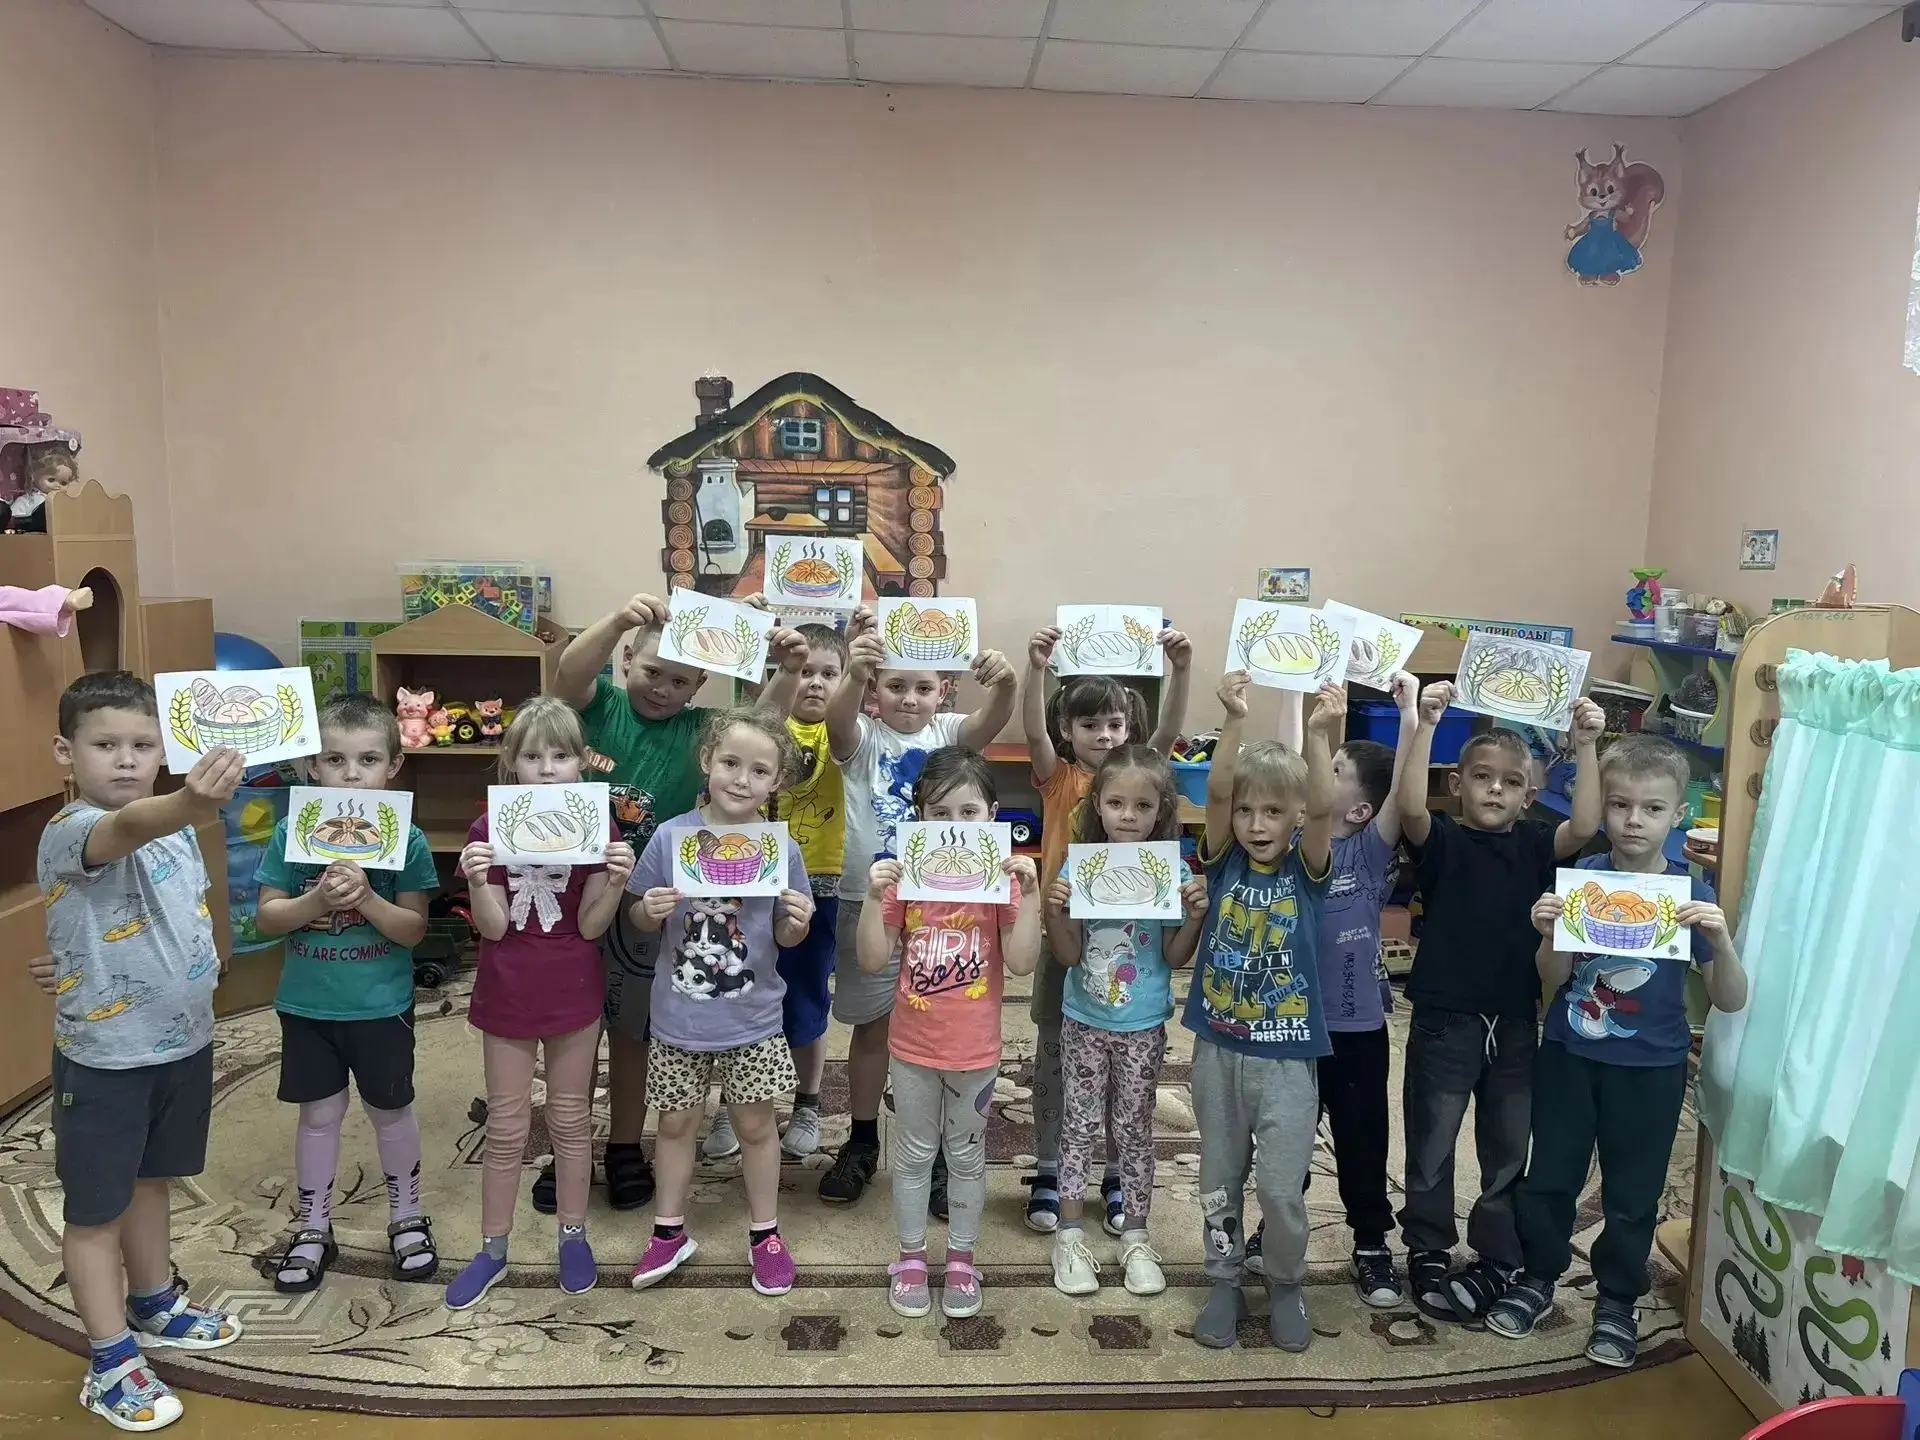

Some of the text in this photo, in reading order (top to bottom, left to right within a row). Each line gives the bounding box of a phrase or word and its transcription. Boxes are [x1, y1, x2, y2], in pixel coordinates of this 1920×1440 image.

[588, 751, 616, 773] OAD
[312, 946, 337, 961] ARE
[340, 942, 391, 961] COMING
[907, 926, 989, 970] GIRL
[1268, 978, 1305, 1004] RULES
[1247, 1017, 1309, 1031] YORK
[1250, 1029, 1311, 1043] FREESTYLE
